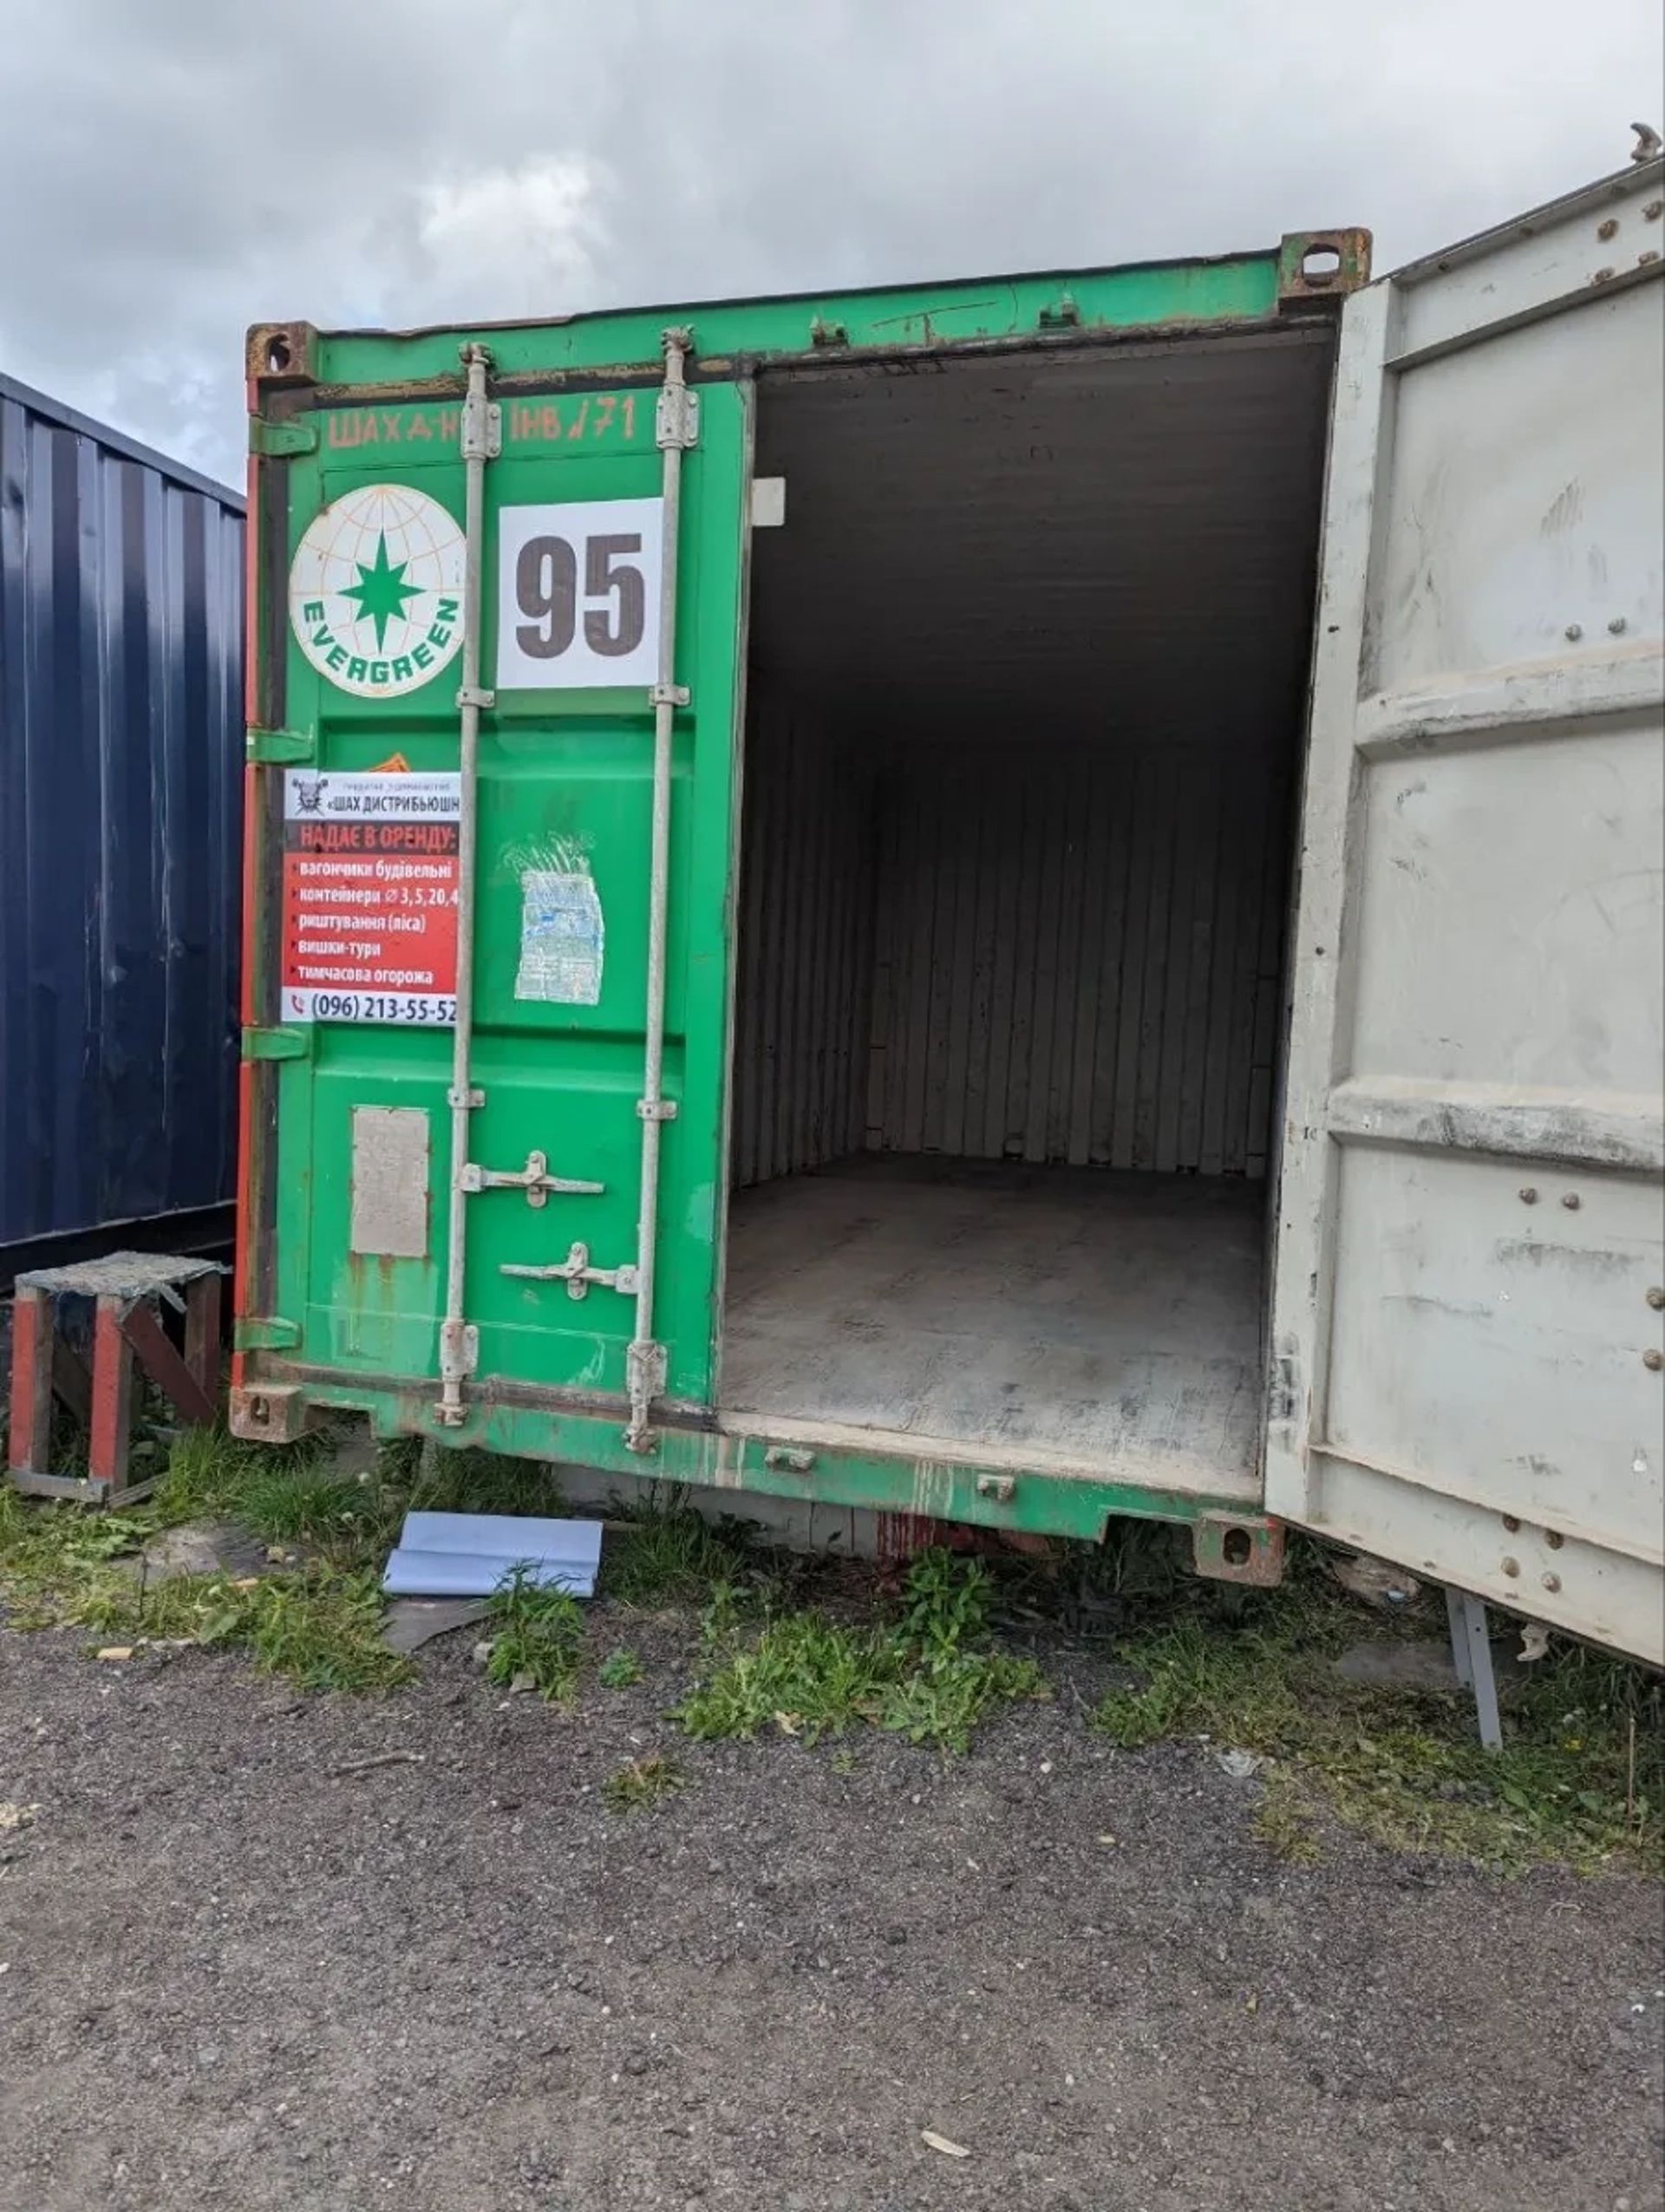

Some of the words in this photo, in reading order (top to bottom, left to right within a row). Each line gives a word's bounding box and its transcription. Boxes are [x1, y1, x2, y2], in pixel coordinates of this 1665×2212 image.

[515, 532, 645, 659] 95
[304, 597, 459, 683] EVERGREEN
[301, 824, 361, 852] НАДАЄ
[363, 825, 375, 848] В
[379, 825, 457, 854] ОРЕНДУ:
[375, 859, 453, 882] будівельні
[299, 885, 381, 907] контейнери
[298, 913, 386, 933] риштування
[388, 913, 427, 933] (ліса)
[297, 965, 372, 982] тимчасова
[374, 968, 434, 987] огорожа
[311, 993, 360, 1020] (096)
[364, 996, 456, 1021] 213-55-52
